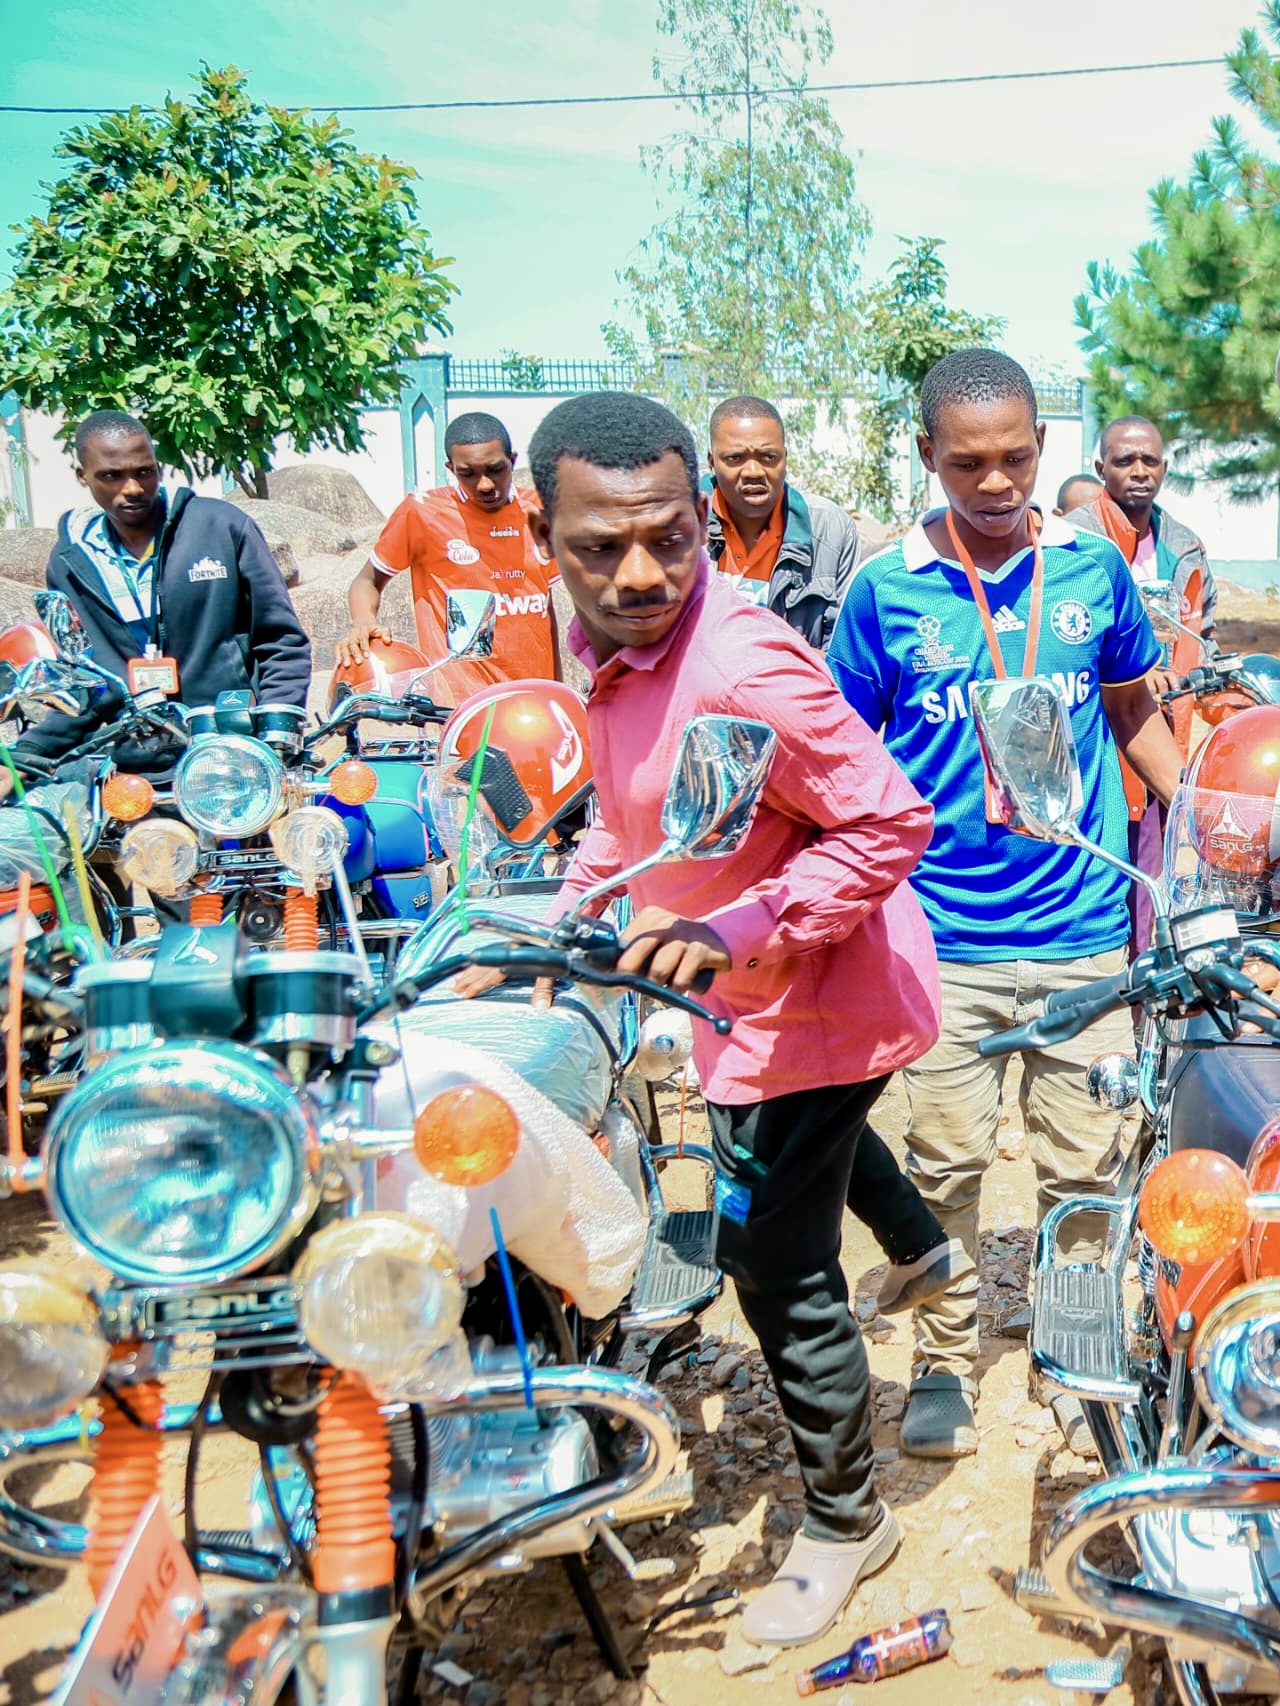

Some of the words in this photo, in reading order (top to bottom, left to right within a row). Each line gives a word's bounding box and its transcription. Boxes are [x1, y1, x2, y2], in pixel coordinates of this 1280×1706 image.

[494, 592, 549, 618] tway
[993, 619, 1026, 633] didas
[922, 671, 1090, 724] SANG
